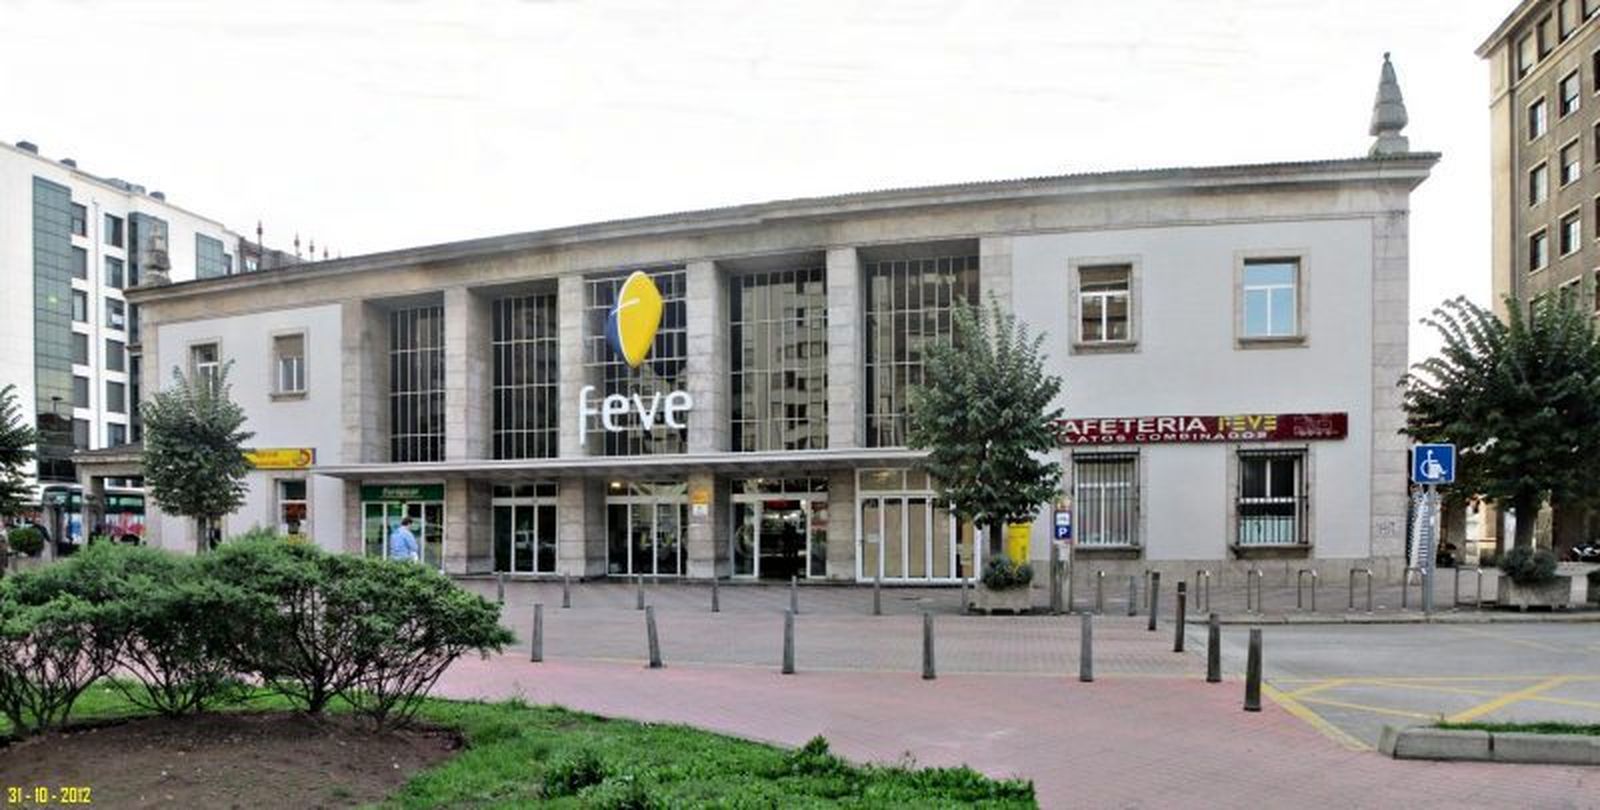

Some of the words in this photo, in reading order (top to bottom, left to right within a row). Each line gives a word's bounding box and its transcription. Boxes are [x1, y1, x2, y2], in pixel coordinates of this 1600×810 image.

[578, 385, 694, 446] feve
[1218, 415, 1278, 431] FEVE
[1058, 434, 1126, 443] LATOS
[1058, 527, 1068, 538] P
